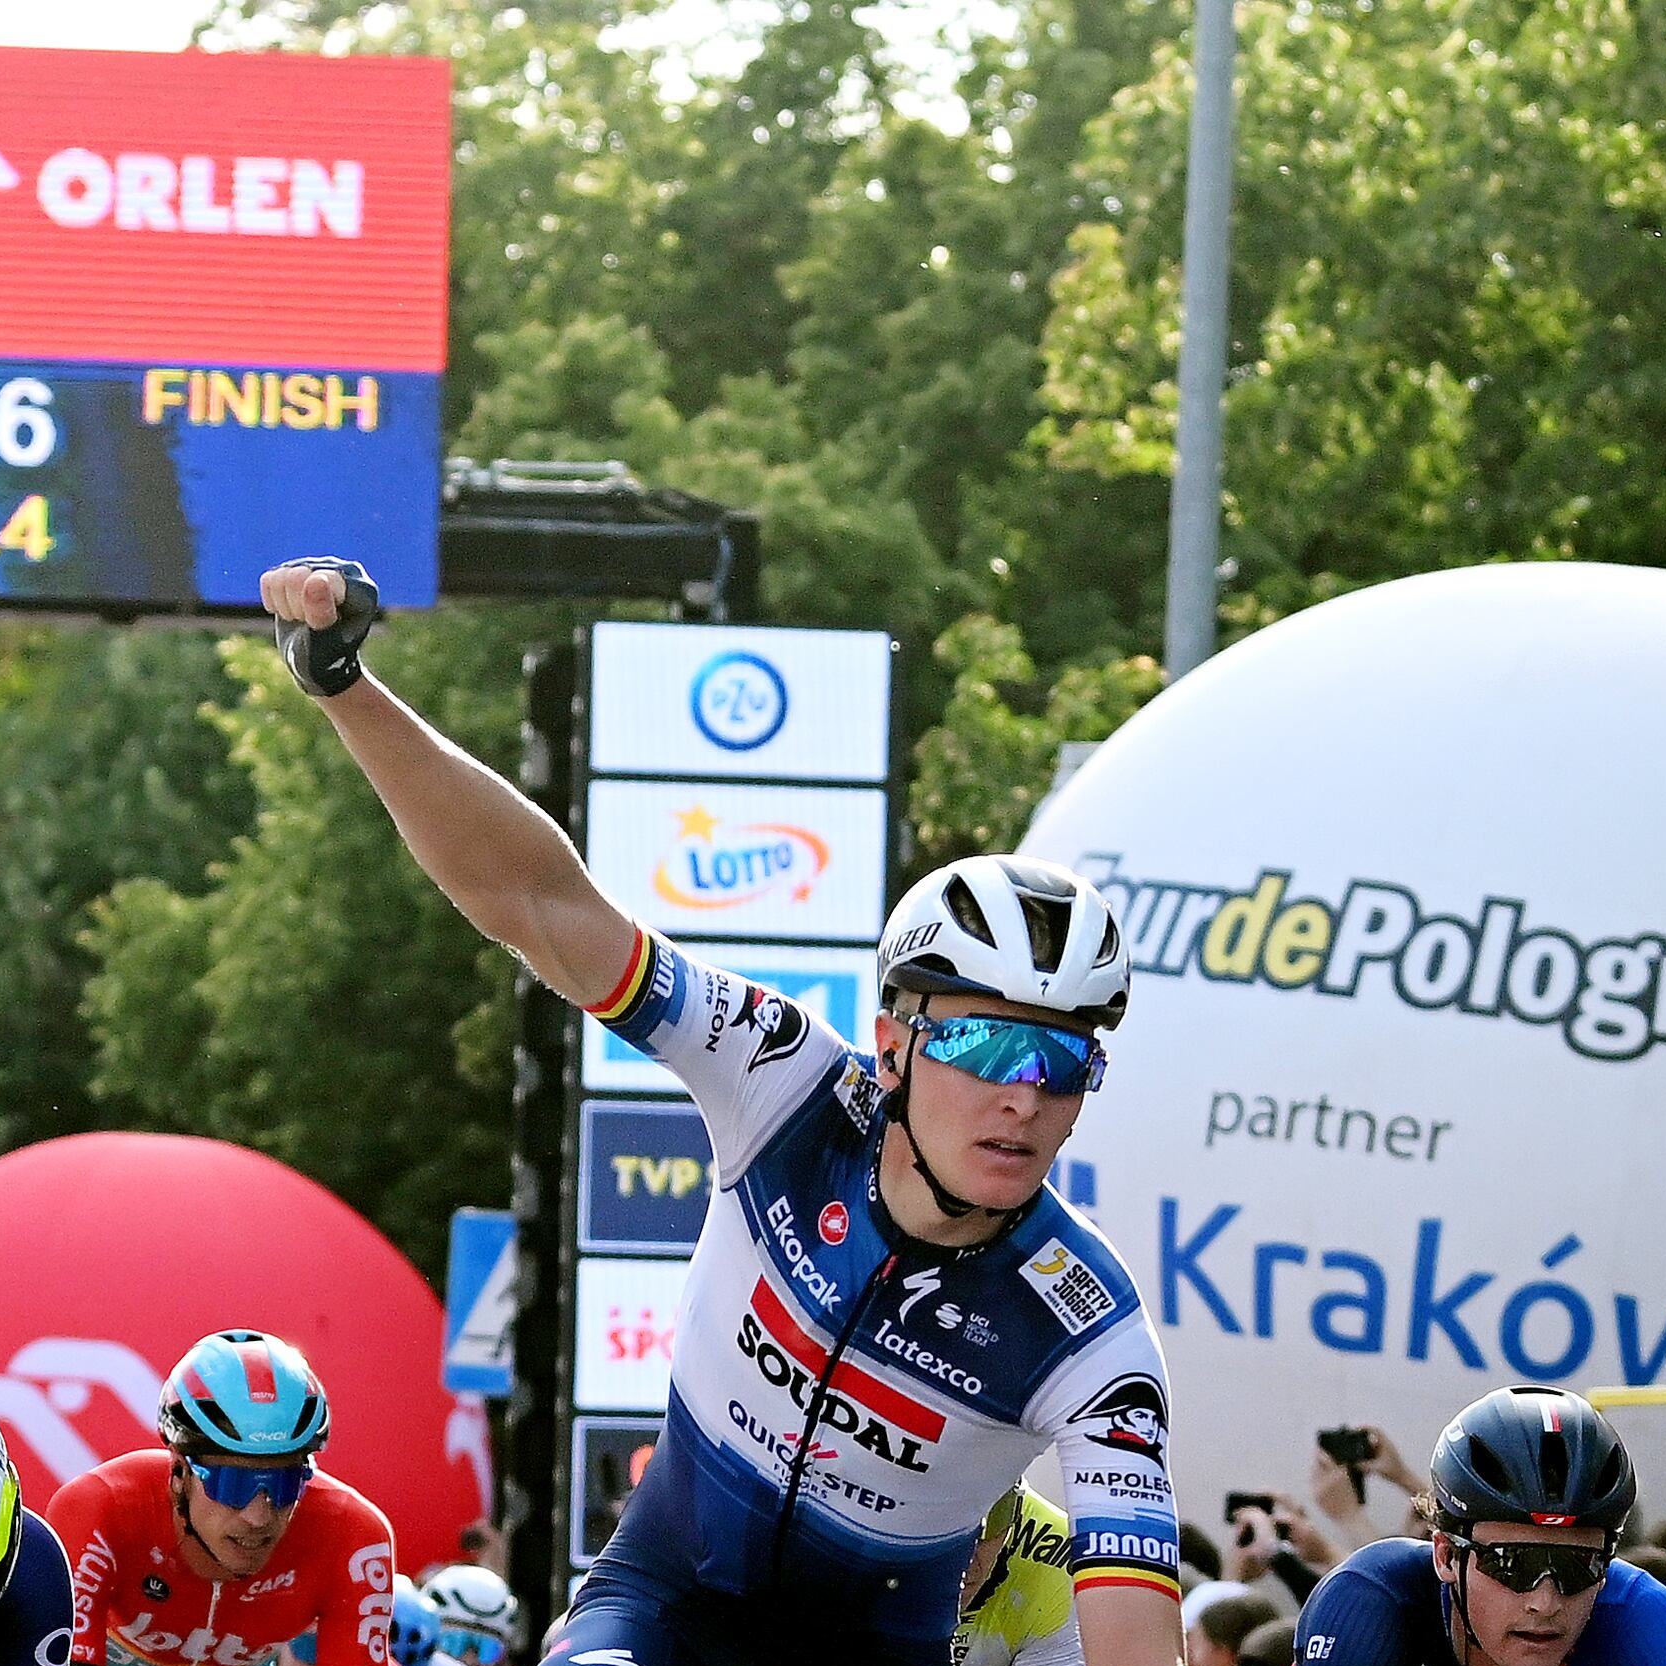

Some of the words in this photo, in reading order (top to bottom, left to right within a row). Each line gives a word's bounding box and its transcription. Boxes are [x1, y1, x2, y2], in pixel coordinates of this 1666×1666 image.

[36, 149, 364, 239] ORLEN
[142, 370, 379, 431] FINISH
[687, 842, 793, 890] LOTTO
[1204, 1088, 1453, 1163] partner
[613, 1157, 699, 1196] TVP
[766, 1196, 841, 1312] Ekopak
[1052, 1277, 1096, 1324] JOGGER
[1067, 1264, 1112, 1311] SAFETY
[970, 1313, 990, 1327] UCI
[874, 1320, 984, 1395] latexco
[737, 1313, 930, 1473] SOUDAL
[1075, 1472, 1172, 1494] NAPOLEO
[1110, 1488, 1164, 1503] SPORTS
